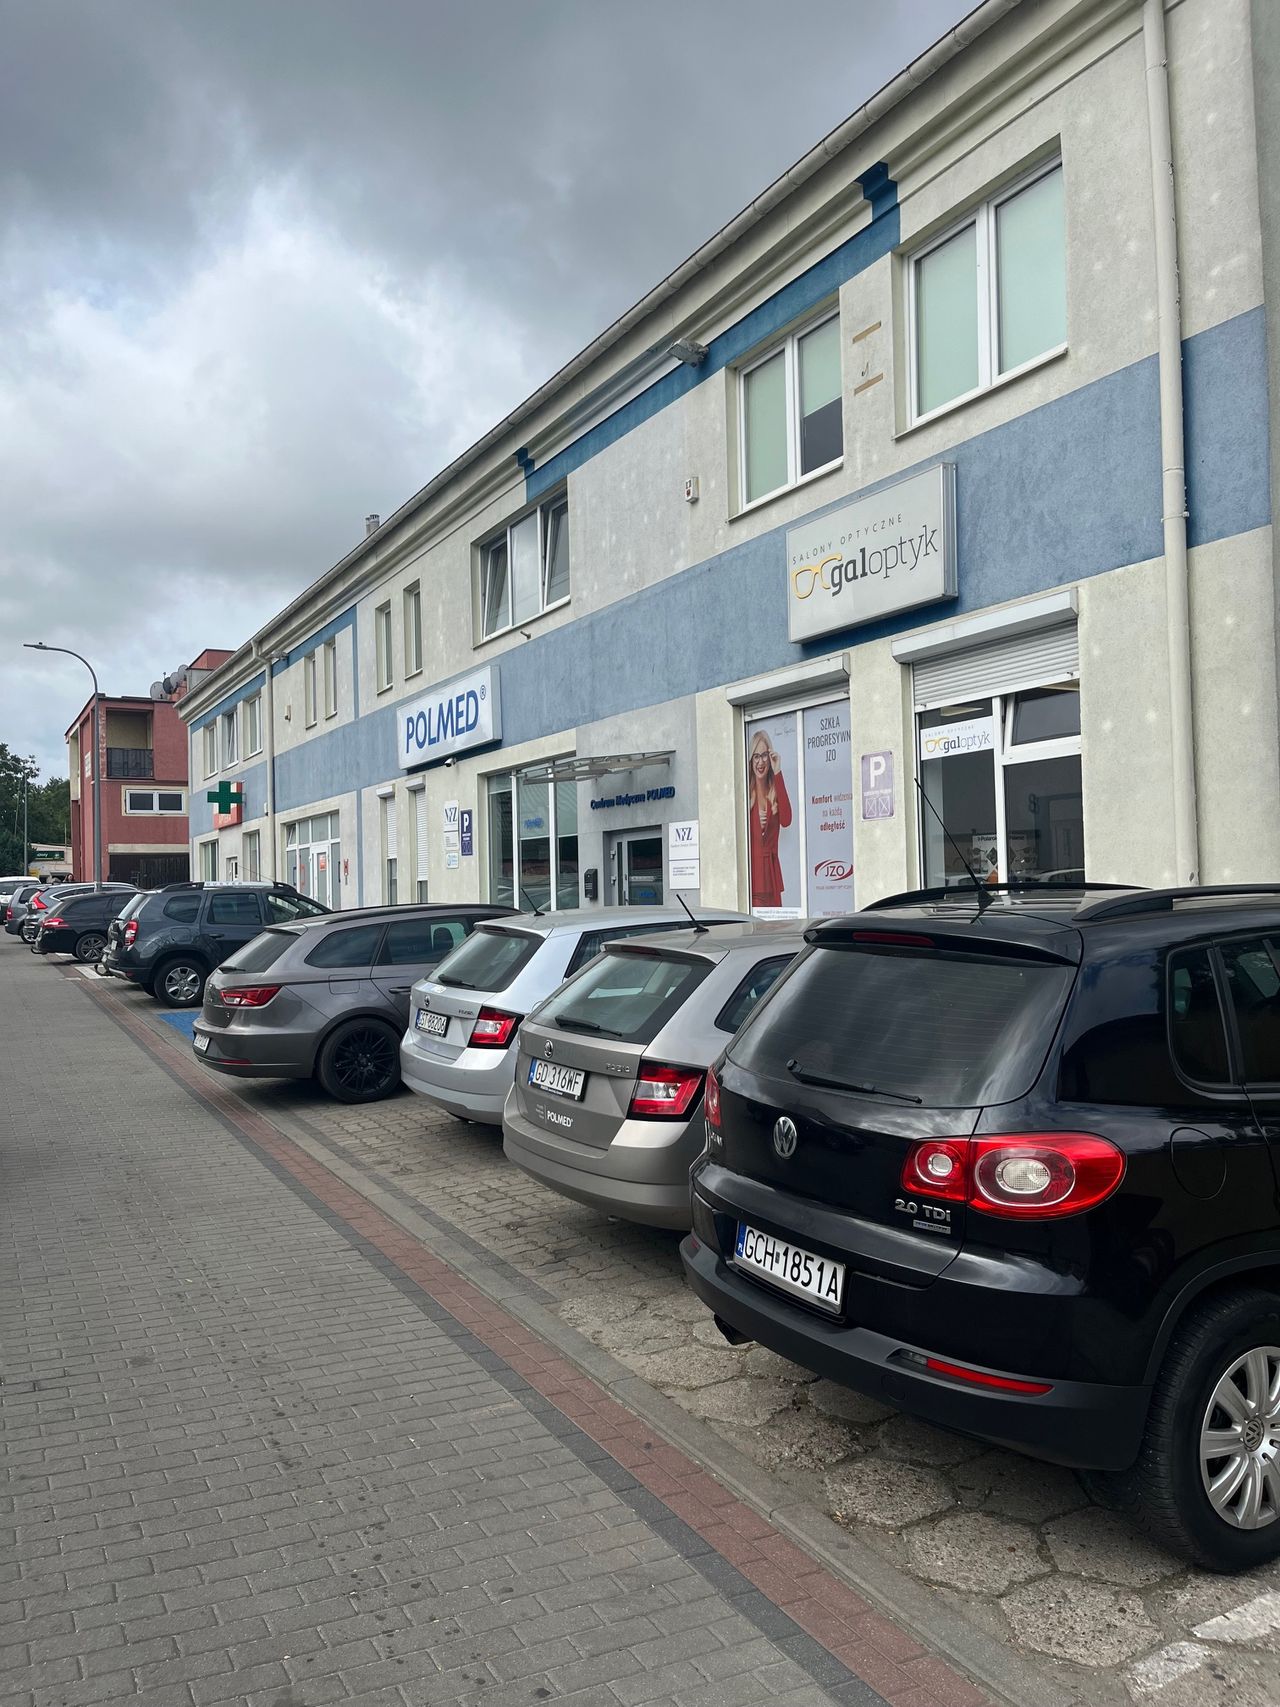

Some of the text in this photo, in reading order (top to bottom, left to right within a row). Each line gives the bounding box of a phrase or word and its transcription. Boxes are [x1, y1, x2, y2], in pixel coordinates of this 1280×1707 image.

[792, 513, 903, 565] SALONY OPTYCZNE
[830, 525, 938, 597] galoptyk
[820, 715, 840, 731] SZKŁA
[943, 731, 991, 754] galoptyk
[825, 749, 837, 762] JZO
[870, 755, 886, 789] P
[811, 794, 833, 805] Komfort
[463, 813, 470, 833] P
[675, 827, 693, 841] NFZ
[825, 865, 845, 877] JZO
[535, 1059, 582, 1092] GD 316WF
[895, 1198, 918, 1214] 2.0
[745, 1229, 838, 1302] GCH 1851A
